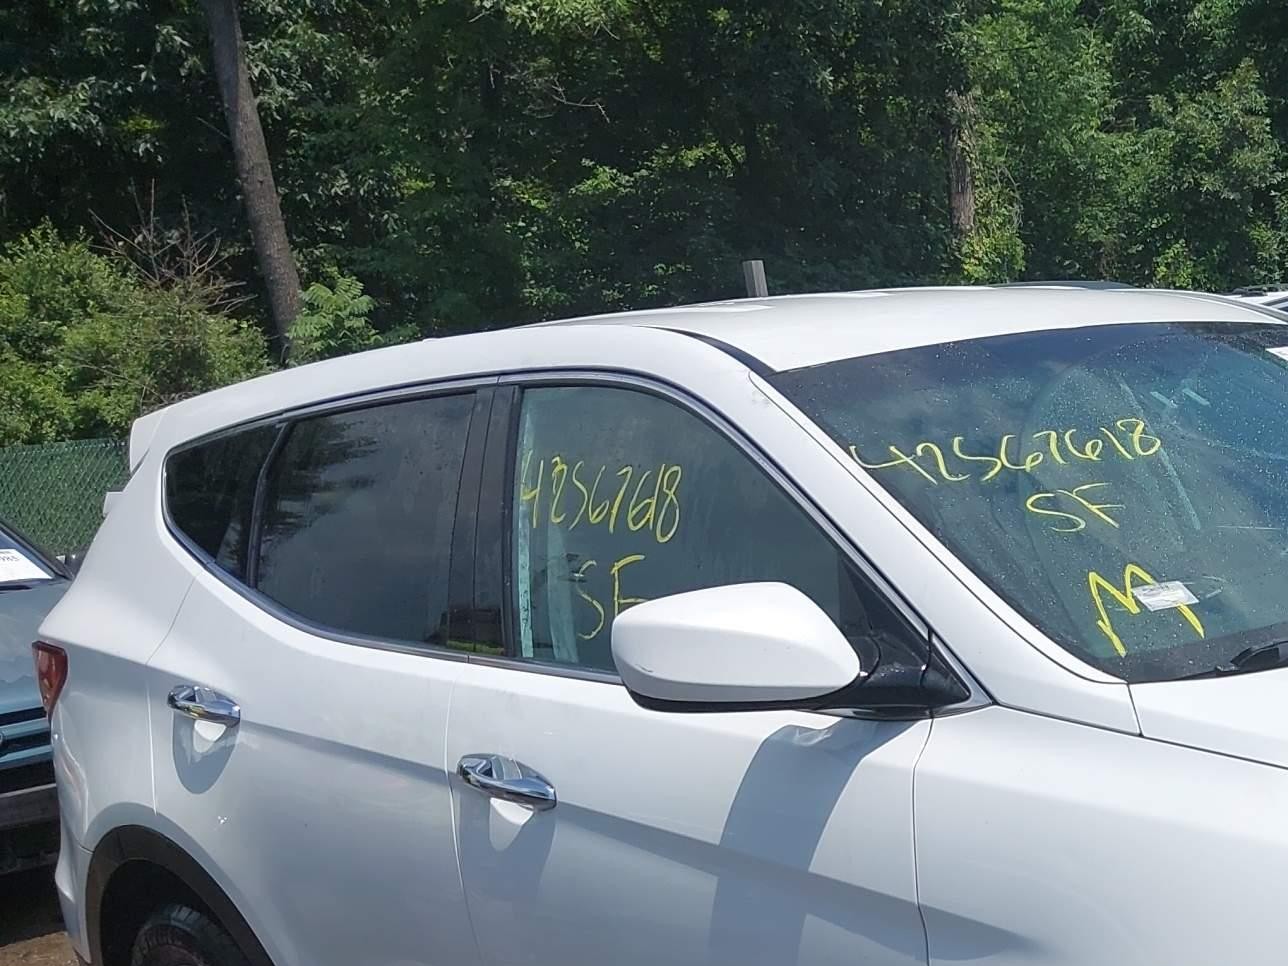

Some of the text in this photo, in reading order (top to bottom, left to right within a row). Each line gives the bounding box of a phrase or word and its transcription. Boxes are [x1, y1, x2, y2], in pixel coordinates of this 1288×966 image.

[850, 418, 1162, 485] 42567618
[520, 450, 682, 543] 42567618
[1026, 482, 1126, 532] SF
[573, 554, 652, 641] SF
[1089, 563, 1205, 658] M
